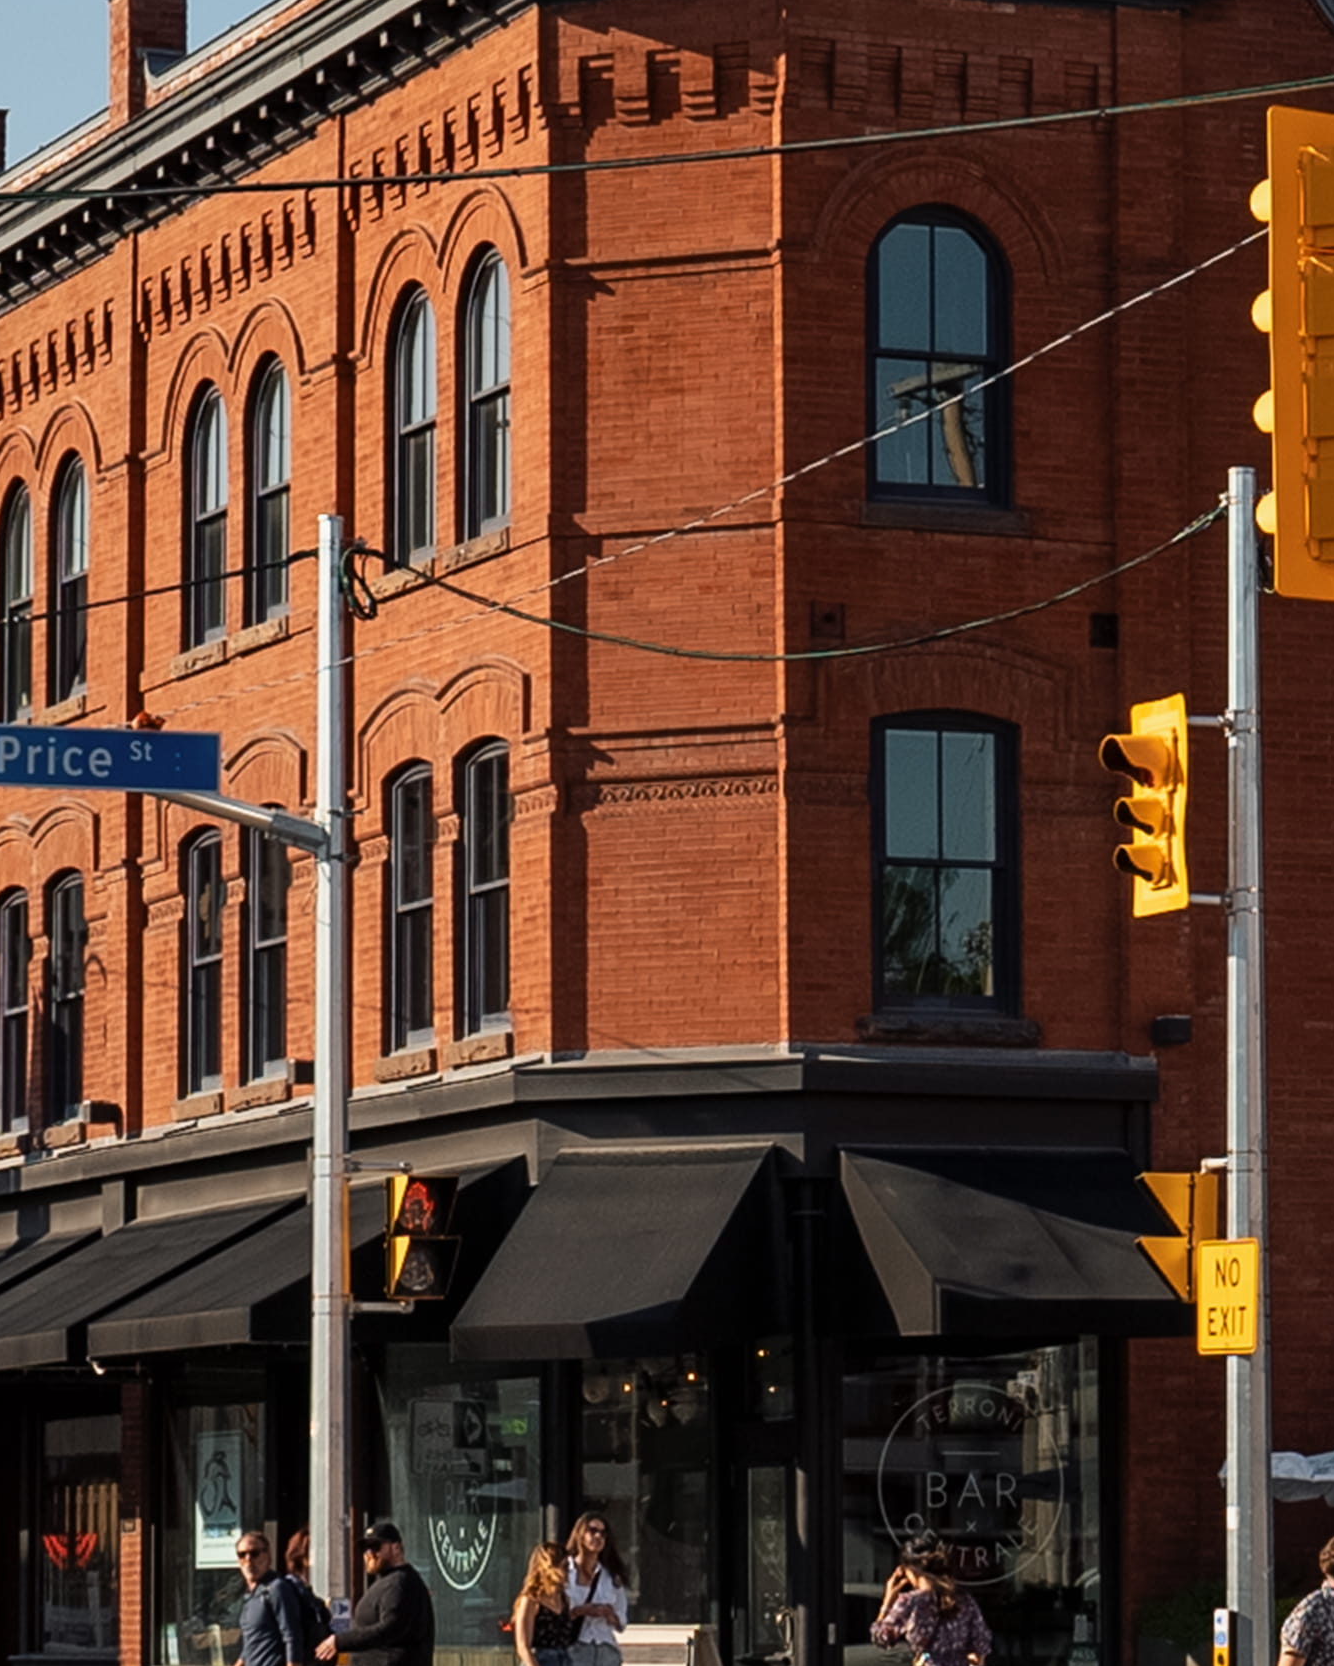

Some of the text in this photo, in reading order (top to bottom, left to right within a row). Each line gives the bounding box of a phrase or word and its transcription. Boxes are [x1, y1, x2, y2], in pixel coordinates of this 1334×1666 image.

[129, 740, 153, 761] St
[1215, 1257, 1241, 1288] NO
[1208, 1306, 1246, 1336] EXIT
[917, 1398, 1023, 1432] TERRONI
[926, 1471, 1017, 1508] BAR
[436, 1519, 489, 1573] CENTRALE
